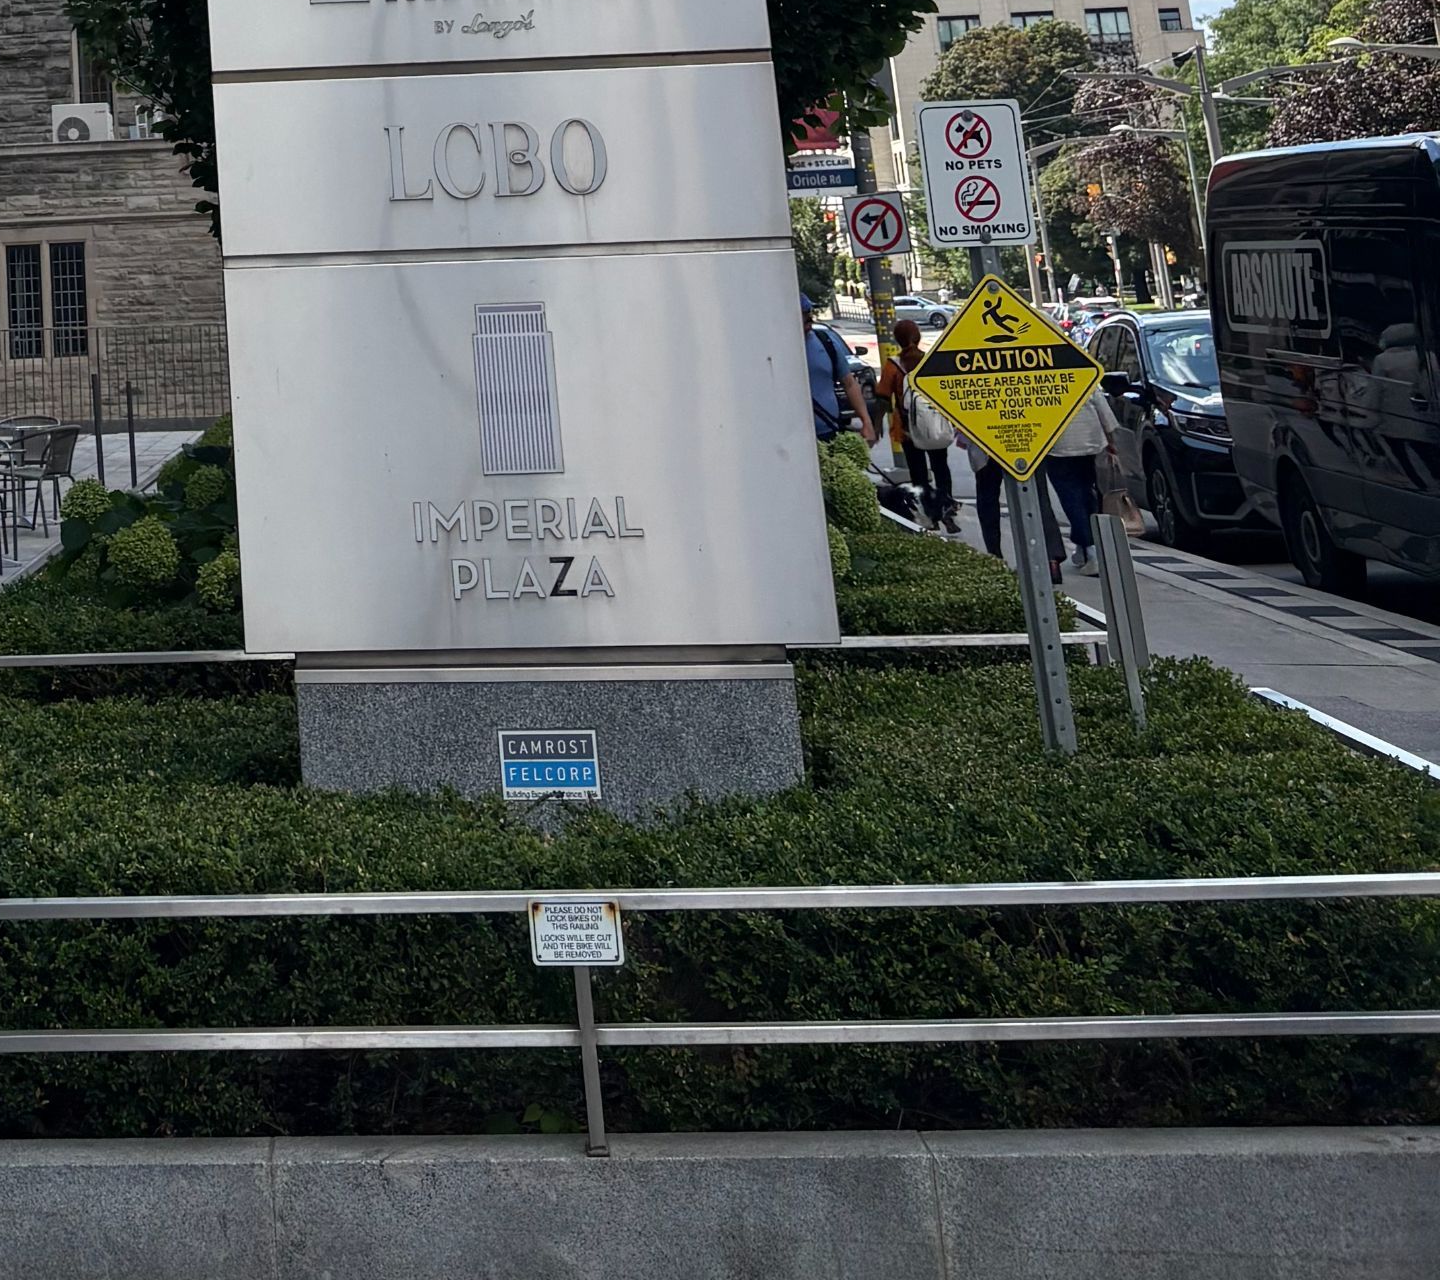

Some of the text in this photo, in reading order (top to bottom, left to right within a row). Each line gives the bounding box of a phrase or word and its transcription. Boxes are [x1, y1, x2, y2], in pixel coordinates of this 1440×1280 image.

[433, 19, 455, 35] BY
[384, 117, 610, 202] LCBO
[945, 159, 1003, 171] NO PETS
[792, 173, 842, 187] Oriole Rd
[939, 223, 1026, 236] NO SMOKING
[1231, 252, 1320, 321] ABSOLUTE
[955, 348, 1054, 372] CAUTION
[939, 372, 1076, 390] SURFACE AREAS MAY BE
[949, 384, 1070, 401] SLIPPERY OR UNEVEN
[959, 395, 1062, 411] USE AT YOUR OWN
[999, 409, 1026, 420] RISK
[412, 496, 644, 543] IMPERIAL
[450, 555, 615, 600] PLAZA
[508, 740, 587, 754] CAMROST
[509, 767, 591, 781] FELCORP
[544, 906, 573, 914] PLEASE
[569, 922, 599, 930] RAILING
[540, 934, 566, 942] LOCKS
[576, 942, 594, 950] BIKE
[594, 942, 612, 950] WILL
[565, 951, 602, 959] REMOVED
